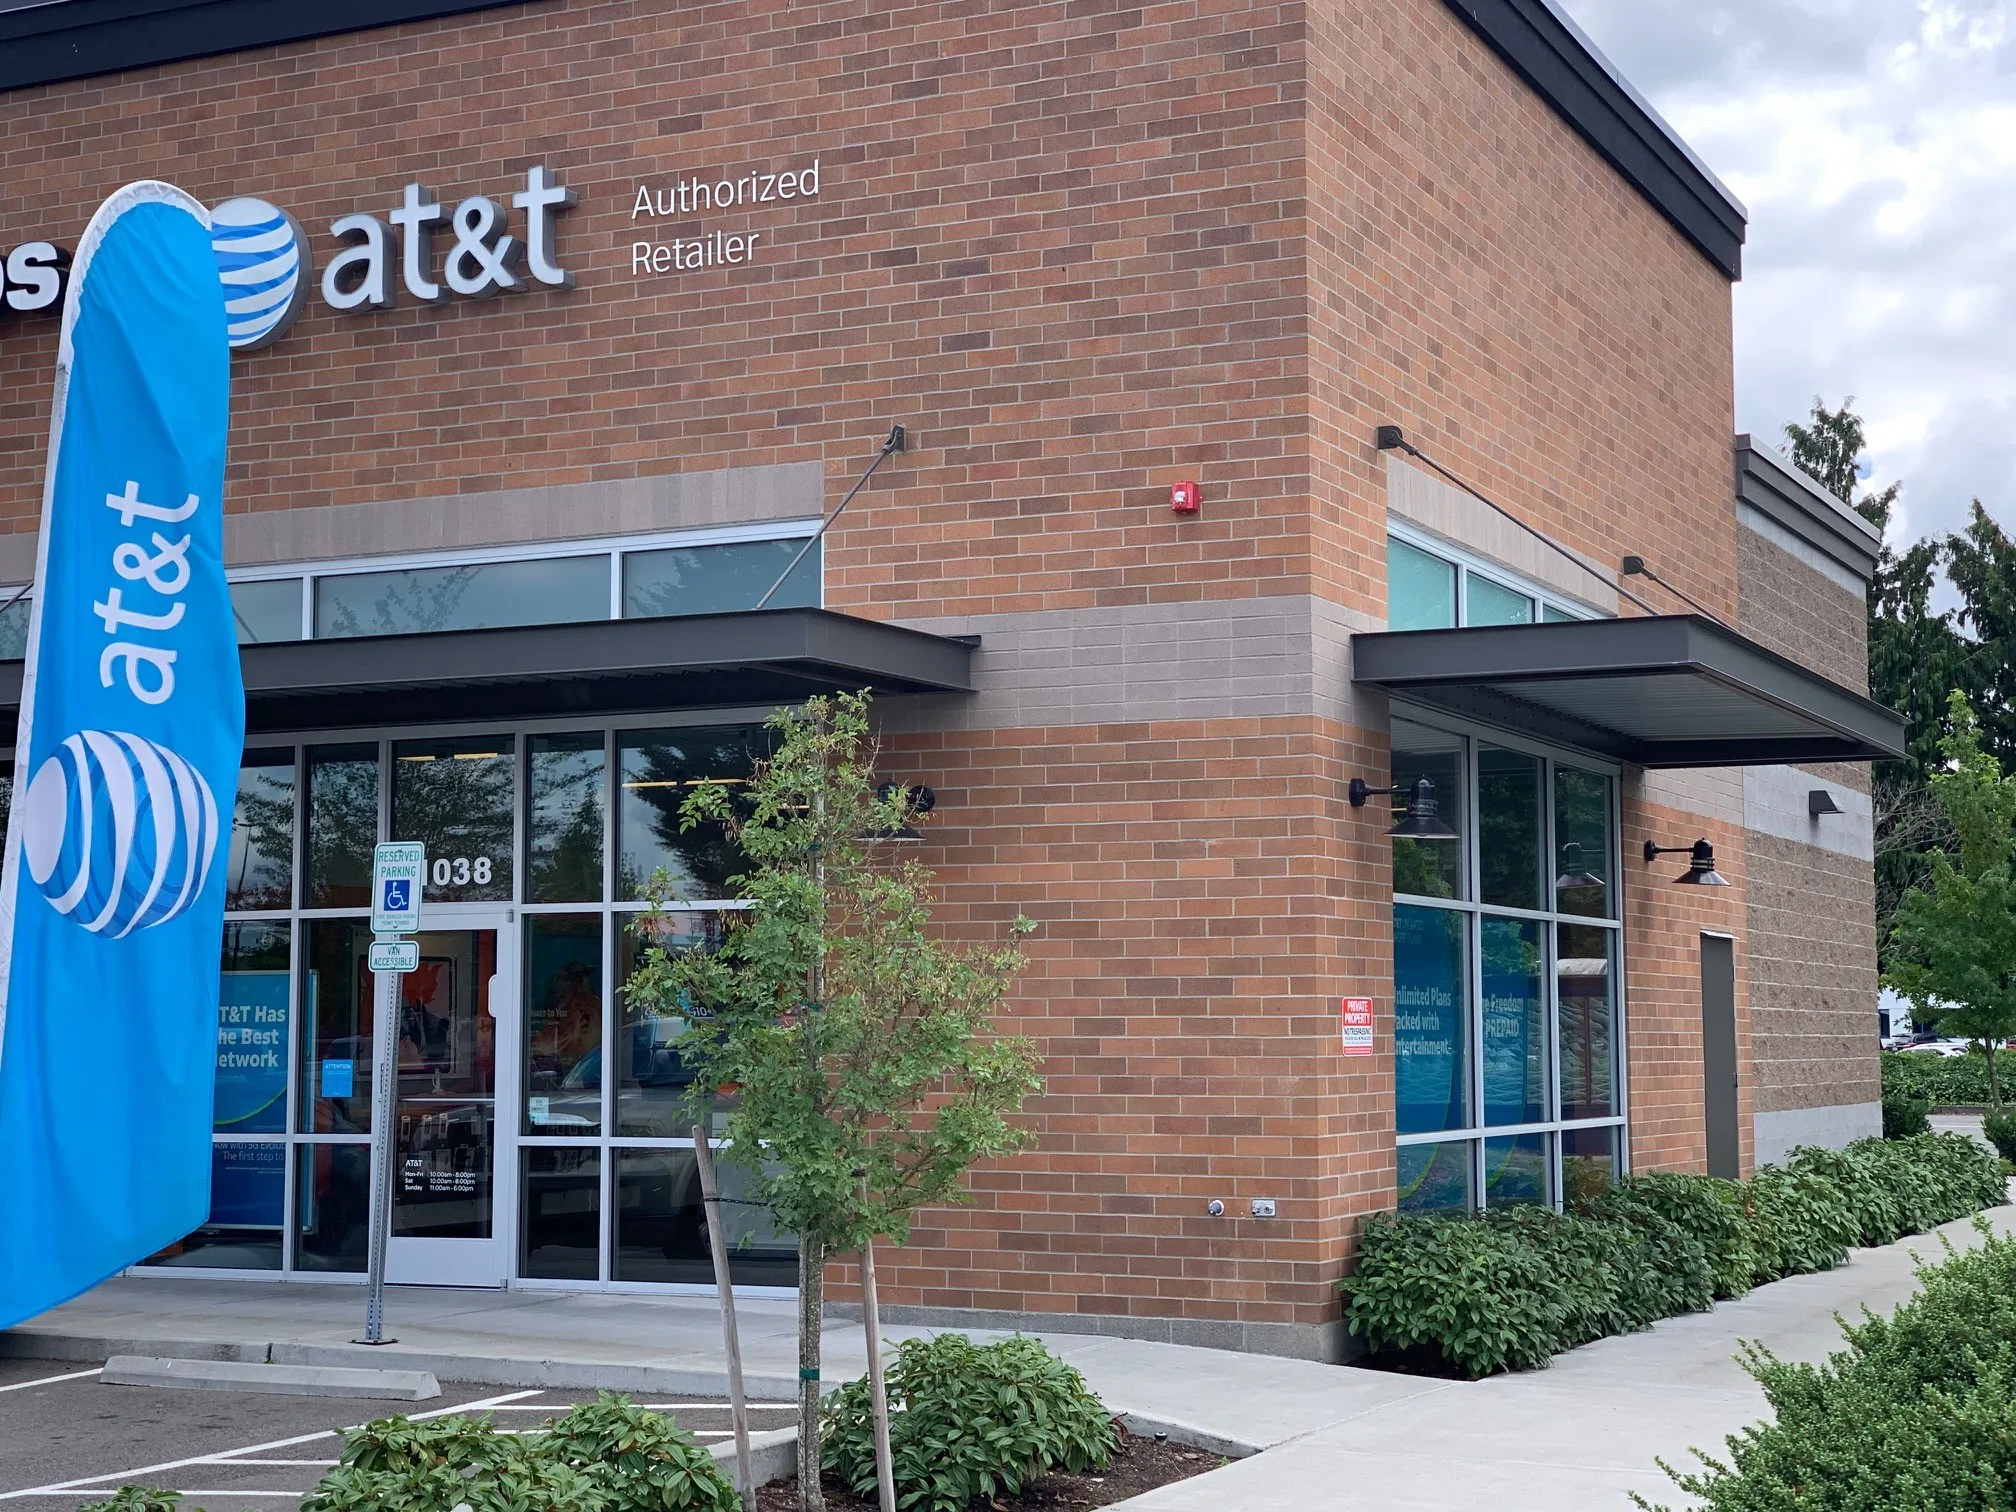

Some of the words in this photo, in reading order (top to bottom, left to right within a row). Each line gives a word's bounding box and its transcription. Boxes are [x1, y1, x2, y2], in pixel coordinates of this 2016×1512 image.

[631, 160, 820, 220] Authorized
[320, 165, 572, 311] at&t
[631, 232, 761, 276] Retailer
[0, 241, 60, 311] s
[93, 480, 200, 705] at&t
[379, 850, 420, 862] RESERVED
[381, 866, 416, 877] PARKING
[387, 945, 400, 956] VAN
[373, 956, 413, 967] ACCESSIBLE
[1347, 1000, 1368, 1012] PRIVATE
[1431, 987, 1452, 1007] Plans
[1491, 992, 1523, 1013] Freedom
[218, 1005, 251, 1023] T&T
[254, 1006, 286, 1023] Has
[1344, 1012, 1371, 1025] PROPERTY
[1396, 1010, 1421, 1031] acked
[1422, 1011, 1440, 1031] with
[217, 1026, 236, 1045] he
[241, 1028, 279, 1045] Best
[1485, 1019, 1520, 1038] PREPAID
[215, 1050, 279, 1068] etwork
[223, 1151, 238, 1161] The
[239, 1151, 255, 1161] first
[256, 1152, 273, 1163] step
[275, 1153, 284, 1161] to
